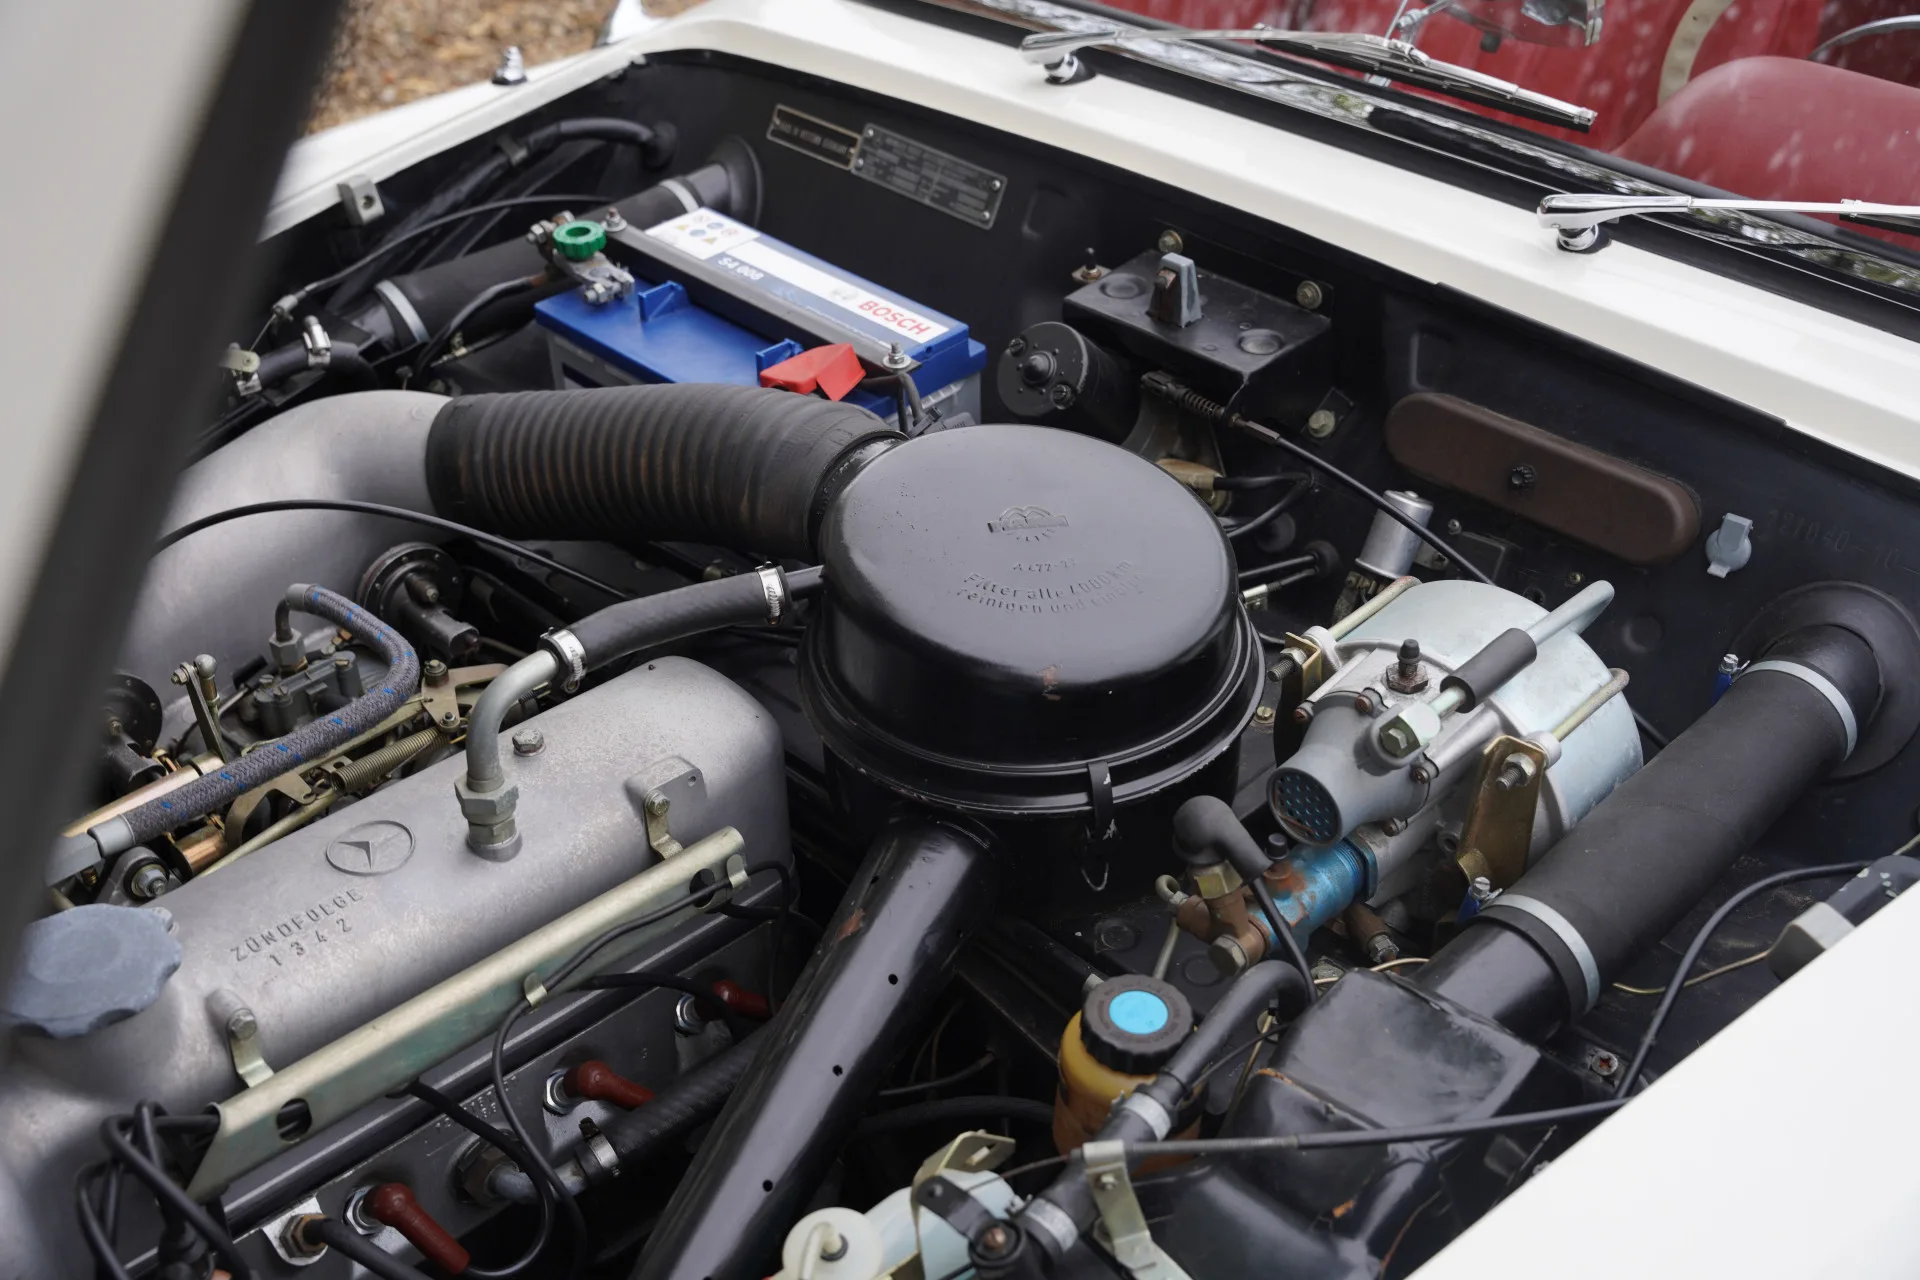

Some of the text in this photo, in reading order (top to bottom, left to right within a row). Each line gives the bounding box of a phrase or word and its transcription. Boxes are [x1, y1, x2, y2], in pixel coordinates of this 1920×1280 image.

[858, 300, 931, 335] BOSCH
[957, 588, 1043, 614] reinigen
[230, 888, 363, 962] ZÜNDFOLGE
